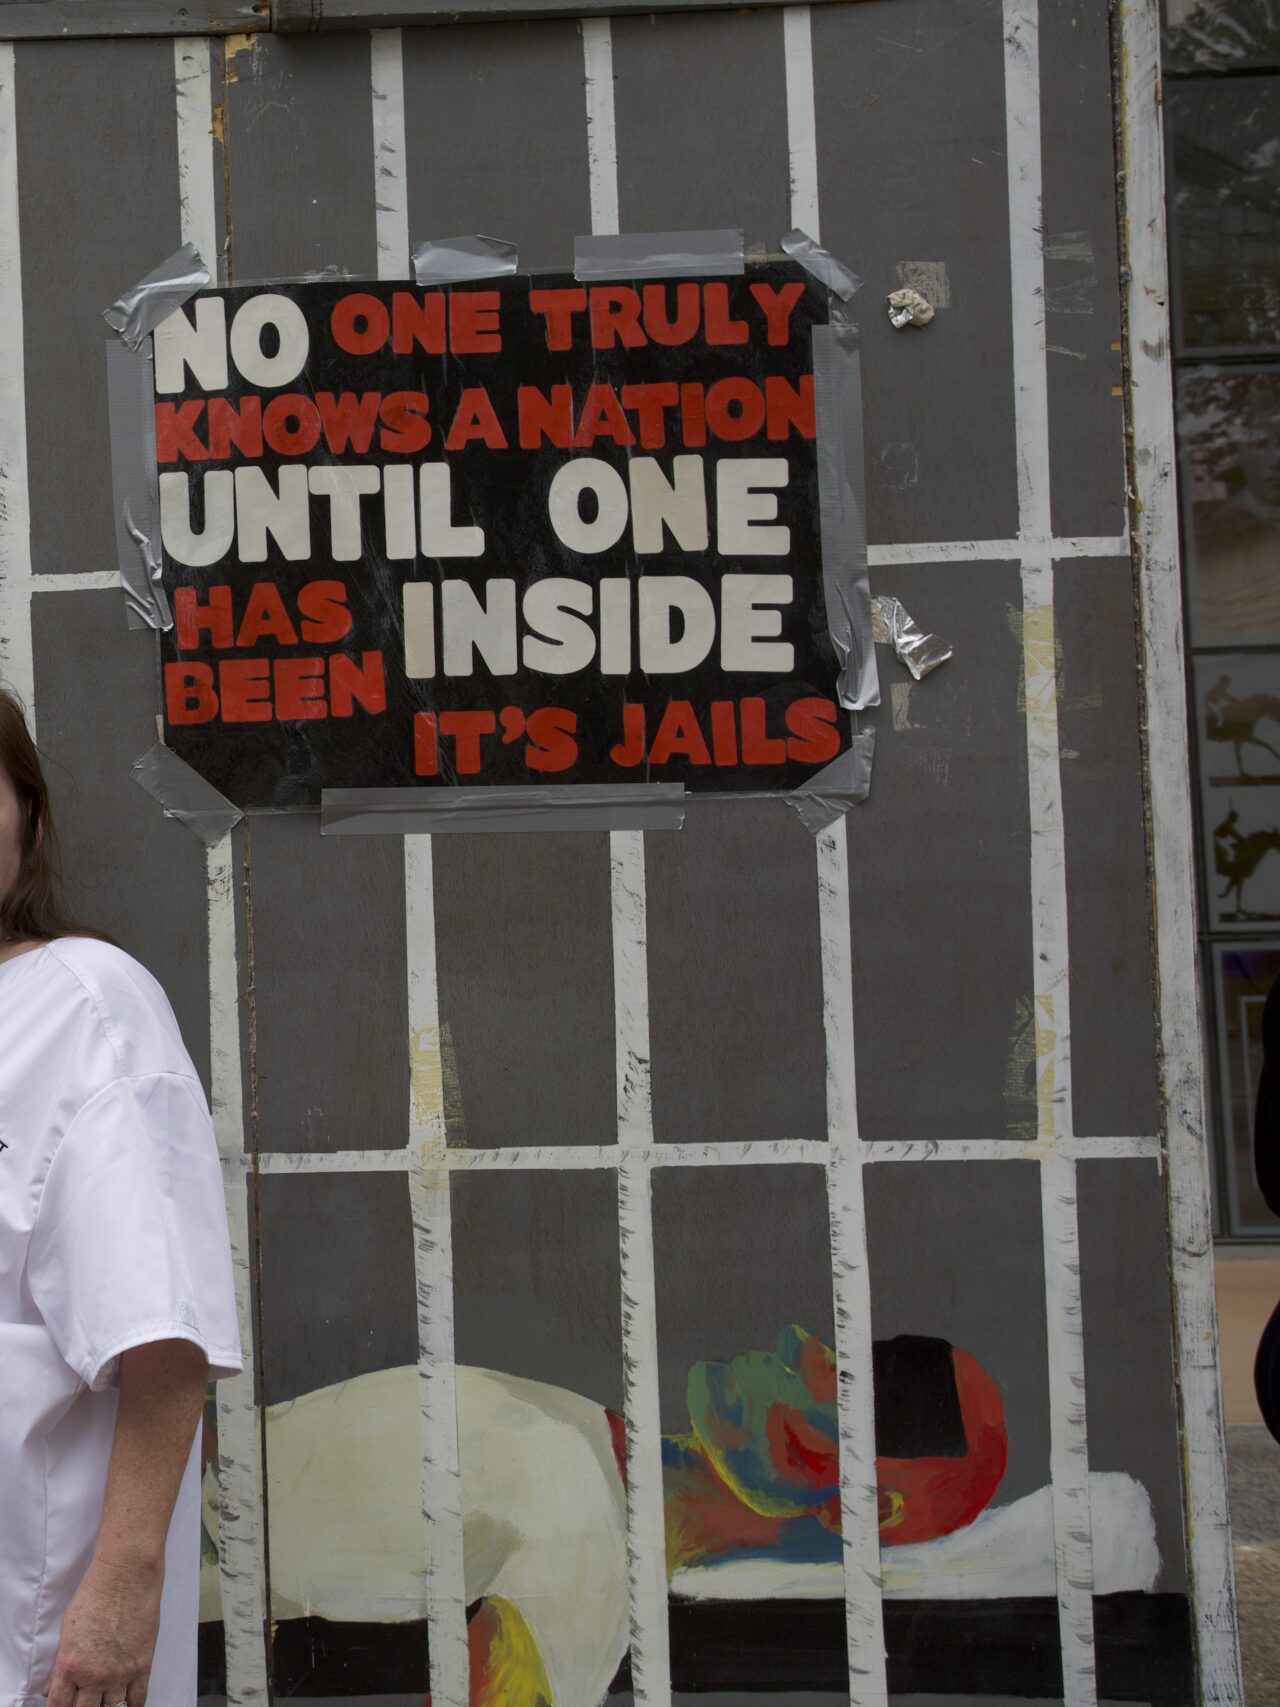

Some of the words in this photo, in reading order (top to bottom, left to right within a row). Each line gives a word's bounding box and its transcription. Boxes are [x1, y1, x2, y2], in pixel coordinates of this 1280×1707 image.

[153, 294, 309, 394] NO
[330, 291, 502, 354] ONE
[530, 282, 805, 351] TRULY
[155, 391, 431, 462] KNOWS
[444, 388, 508, 451] A
[518, 376, 817, 449] NATION
[159, 462, 485, 567] UNTIL
[548, 454, 791, 556] ONE
[174, 579, 354, 650] HAS
[402, 574, 795, 679] INSIDE
[164, 651, 387, 726] BEEN
[414, 706, 578, 776] IT'S
[610, 697, 841, 767] JAILS
